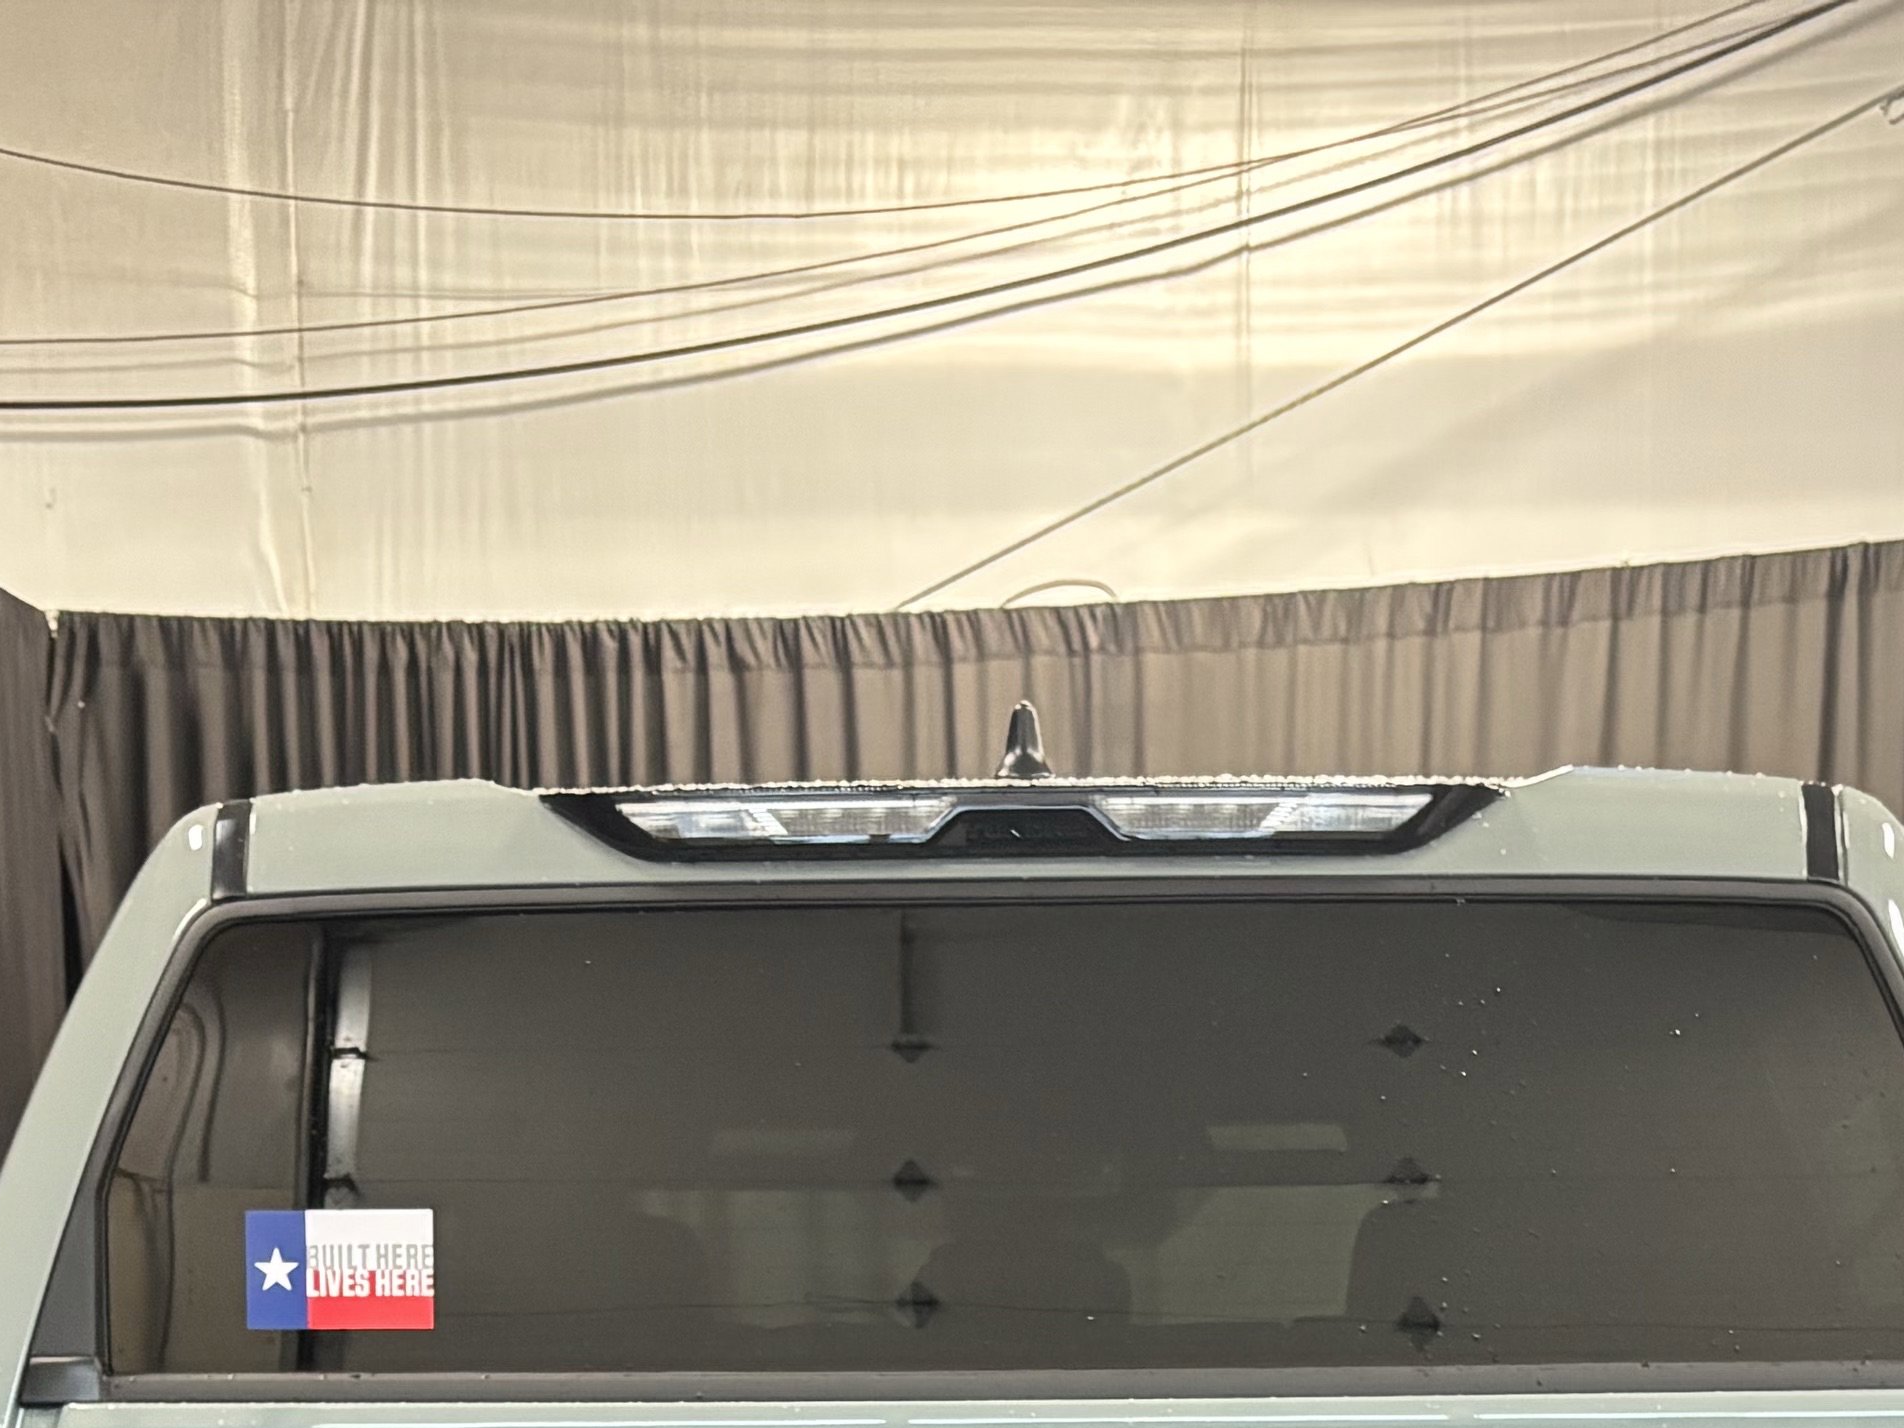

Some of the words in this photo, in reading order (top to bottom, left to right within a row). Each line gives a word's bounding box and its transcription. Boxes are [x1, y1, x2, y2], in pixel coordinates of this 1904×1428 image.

[307, 1243, 370, 1271] BUILT
[376, 1243, 434, 1270] HERE
[306, 1270, 371, 1298] LIVES
[375, 1269, 435, 1297] HERE
